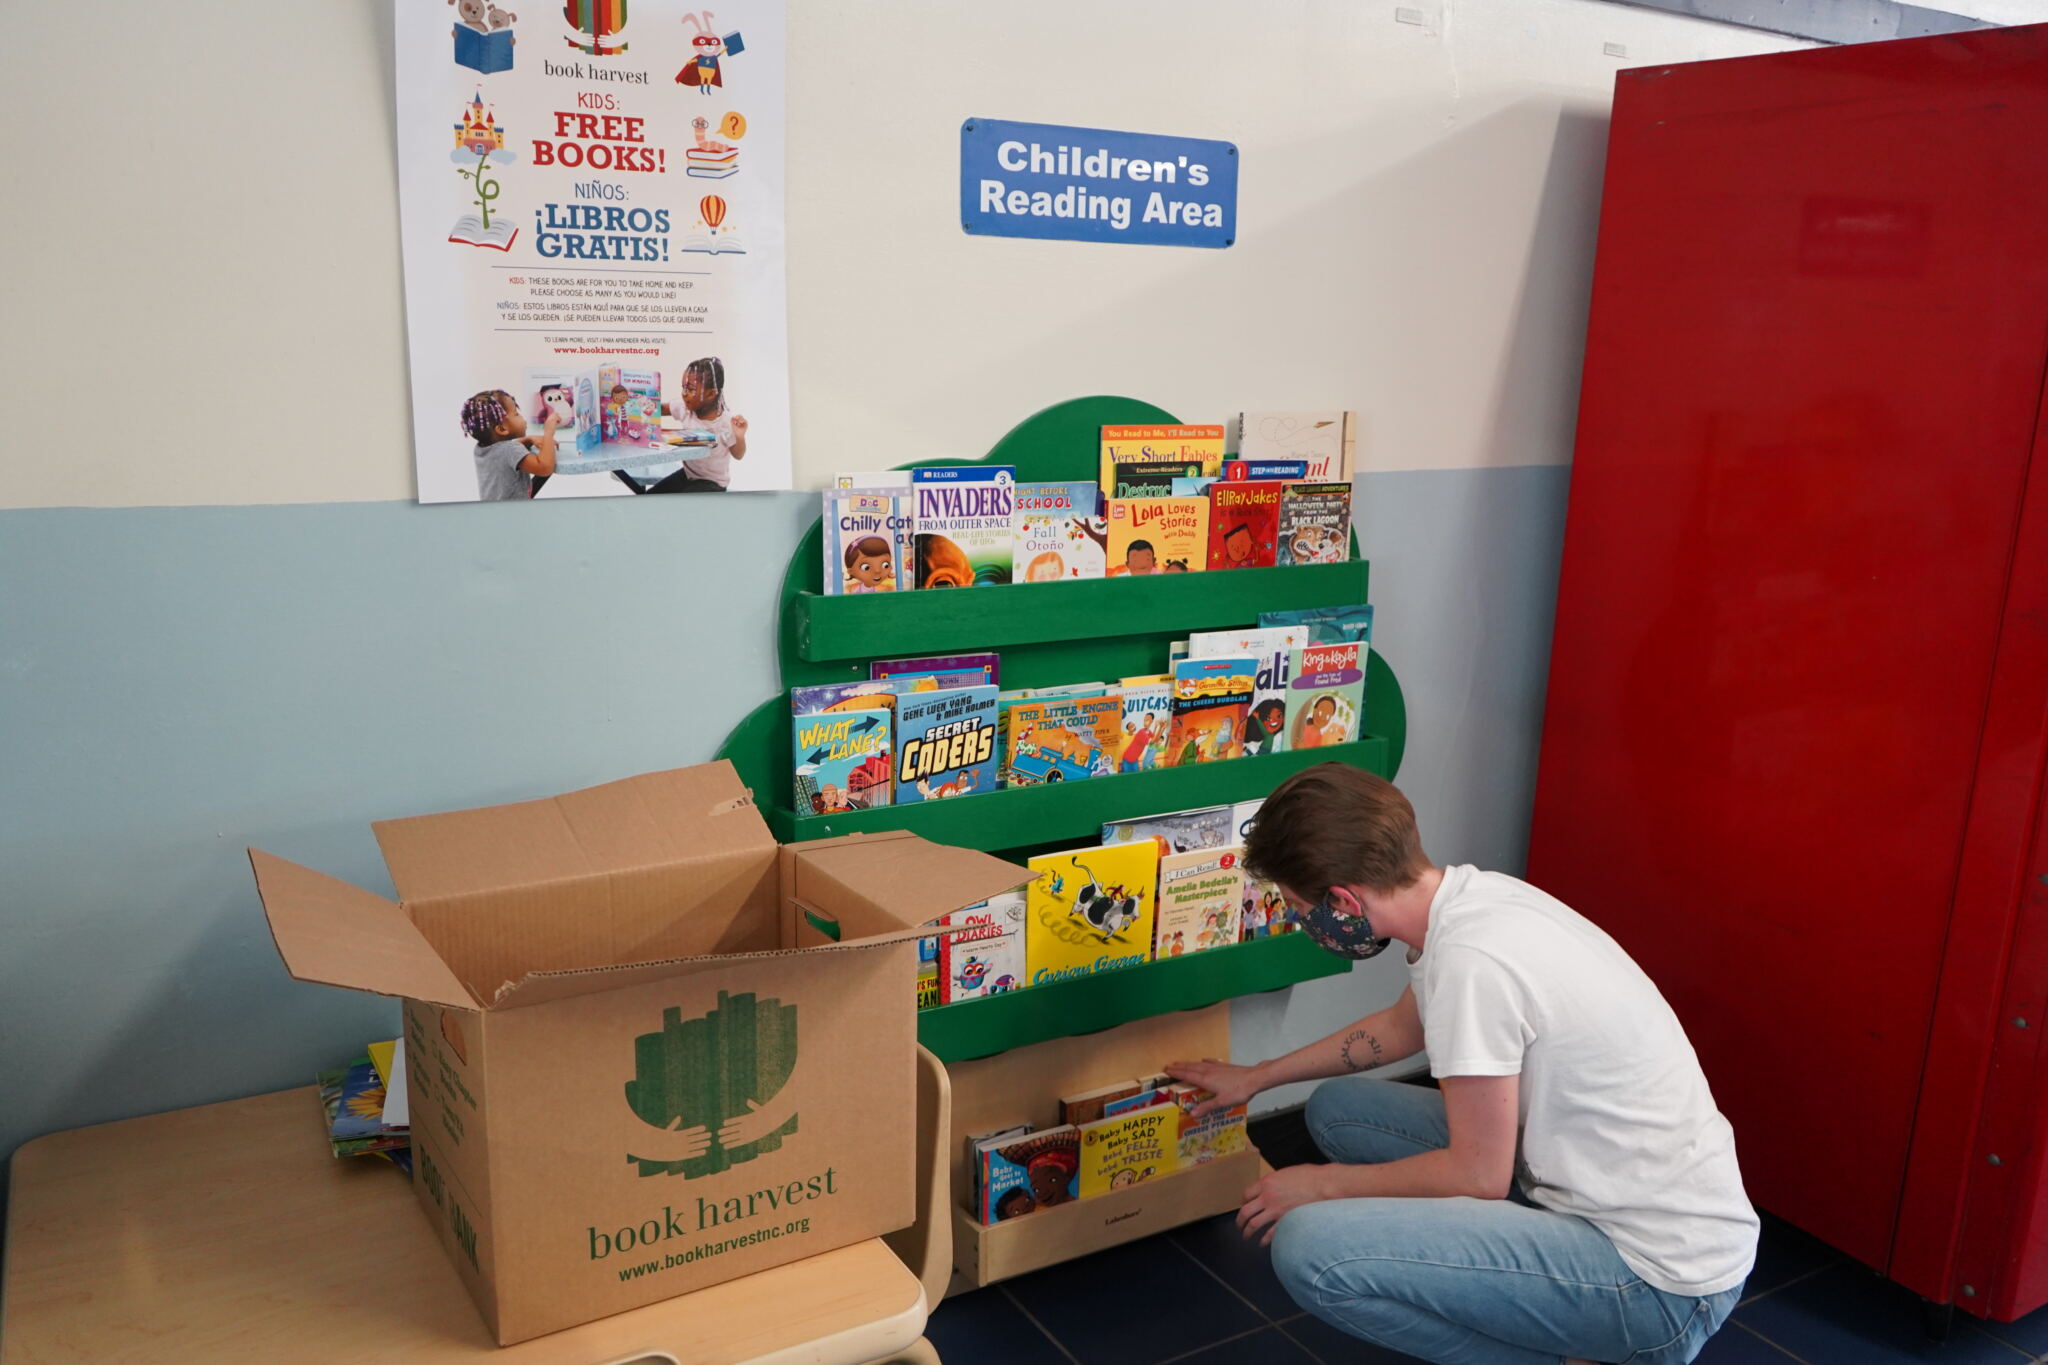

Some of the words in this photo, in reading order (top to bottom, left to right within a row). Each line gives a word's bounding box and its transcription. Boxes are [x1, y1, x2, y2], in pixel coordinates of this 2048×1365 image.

[544, 60, 584, 80] book
[588, 64, 650, 85] harvest
[577, 92, 621, 111] KIDS:
[553, 111, 645, 143] FREE
[531, 140, 667, 173] BOOKS!
[997, 140, 1210, 187] Children's
[574, 179, 630, 201] NIÑOS:
[980, 179, 1131, 230] Reading
[1142, 192, 1223, 228] Area
[535, 203, 671, 235] ¡LIBROS
[535, 232, 670, 262] GRATIS!
[528, 277, 550, 285] THESE
[551, 278, 574, 286] BOOKS
[576, 278, 587, 286] ARE
[629, 280, 643, 288] TAKE
[665, 281, 676, 289] AND
[530, 288, 555, 296] PLEASE
[556, 289, 583, 297] CHOOSE
[638, 291, 659, 299] WOULD
[523, 302, 545, 310] ESTOS
[547, 303, 570, 311] LIBROS
[610, 304, 624, 312] PARA
[625, 304, 639, 312] QUE
[576, 314, 600, 322] PUEDEN
[626, 315, 648, 323] TODOS
[554, 346, 660, 356] www.bookharvestnc.org
[1123, 429, 1142, 437] Read
[1107, 446, 1139, 463] Very
[1141, 445, 1176, 463] Short
[1180, 445, 1218, 462] Fables
[933, 471, 958, 479] READERS
[1236, 467, 1242, 479] 1
[1251, 466, 1265, 475] STEP
[1274, 466, 1299, 474] READING
[999, 475, 1006, 485] 3
[918, 486, 1012, 518] INVADERS
[1216, 489, 1246, 507] EllRay
[1246, 488, 1279, 505] Jakes
[840, 515, 881, 533] Chilly
[918, 519, 947, 530] FROM
[950, 518, 982, 529] OUTER
[984, 517, 1012, 528] SPACE
[1131, 504, 1164, 528] Lola
[1167, 504, 1196, 514] Loves
[1160, 515, 1198, 530] Stories
[1291, 516, 1312, 526] BLACK
[1313, 514, 1340, 525] LAGOON
[1033, 526, 1057, 538] Fall
[1026, 540, 1064, 551] Otoño
[1303, 652, 1324, 672] King
[1330, 646, 1357, 670] Kayla
[903, 708, 924, 721] GENE
[926, 701, 947, 715] LUEN
[949, 695, 972, 709] YANG
[943, 707, 965, 719] MIKE
[965, 699, 996, 713] HOLMES
[1193, 698, 1215, 706] CHEESE
[1216, 695, 1248, 703] BURGLAR
[1018, 710, 1040, 722] THE
[1043, 705, 1078, 719] LITTLE
[1081, 701, 1119, 714] ENGINE
[925, 717, 981, 743] SECRET
[1037, 719, 1064, 731] THAT
[1066, 714, 1098, 727] COULD
[799, 718, 856, 750] WHAT
[829, 725, 887, 761] LANE?
[900, 725, 995, 783] CODERS
[1224, 856, 1231, 865] 2
[1166, 882, 1198, 895] Amelia
[1199, 876, 1239, 889] Bedelia's
[1174, 888, 1229, 904] Masterpiece
[965, 913, 996, 926] OWL
[955, 925, 1003, 942] DIARIES
[1033, 963, 1091, 985] Curious
[1094, 953, 1146, 972] George
[1099, 1128, 1121, 1142] Baby
[1123, 1115, 1166, 1132] HAPPY
[1184, 1125, 1209, 1136] CHEESE
[1211, 1115, 1245, 1129] PYRAMID
[1107, 1137, 1129, 1150] Baby
[1131, 1127, 1156, 1141] SAD
[1126, 1138, 1160, 1153] FELIZ
[1122, 1149, 1164, 1165] TRISTE
[992, 1166, 1013, 1178] Baby
[992, 1176, 1024, 1193] Market
[587, 1205, 687, 1261] book
[696, 1166, 839, 1232] harvest
[618, 1215, 811, 1283] www.bookharvestnc.org
